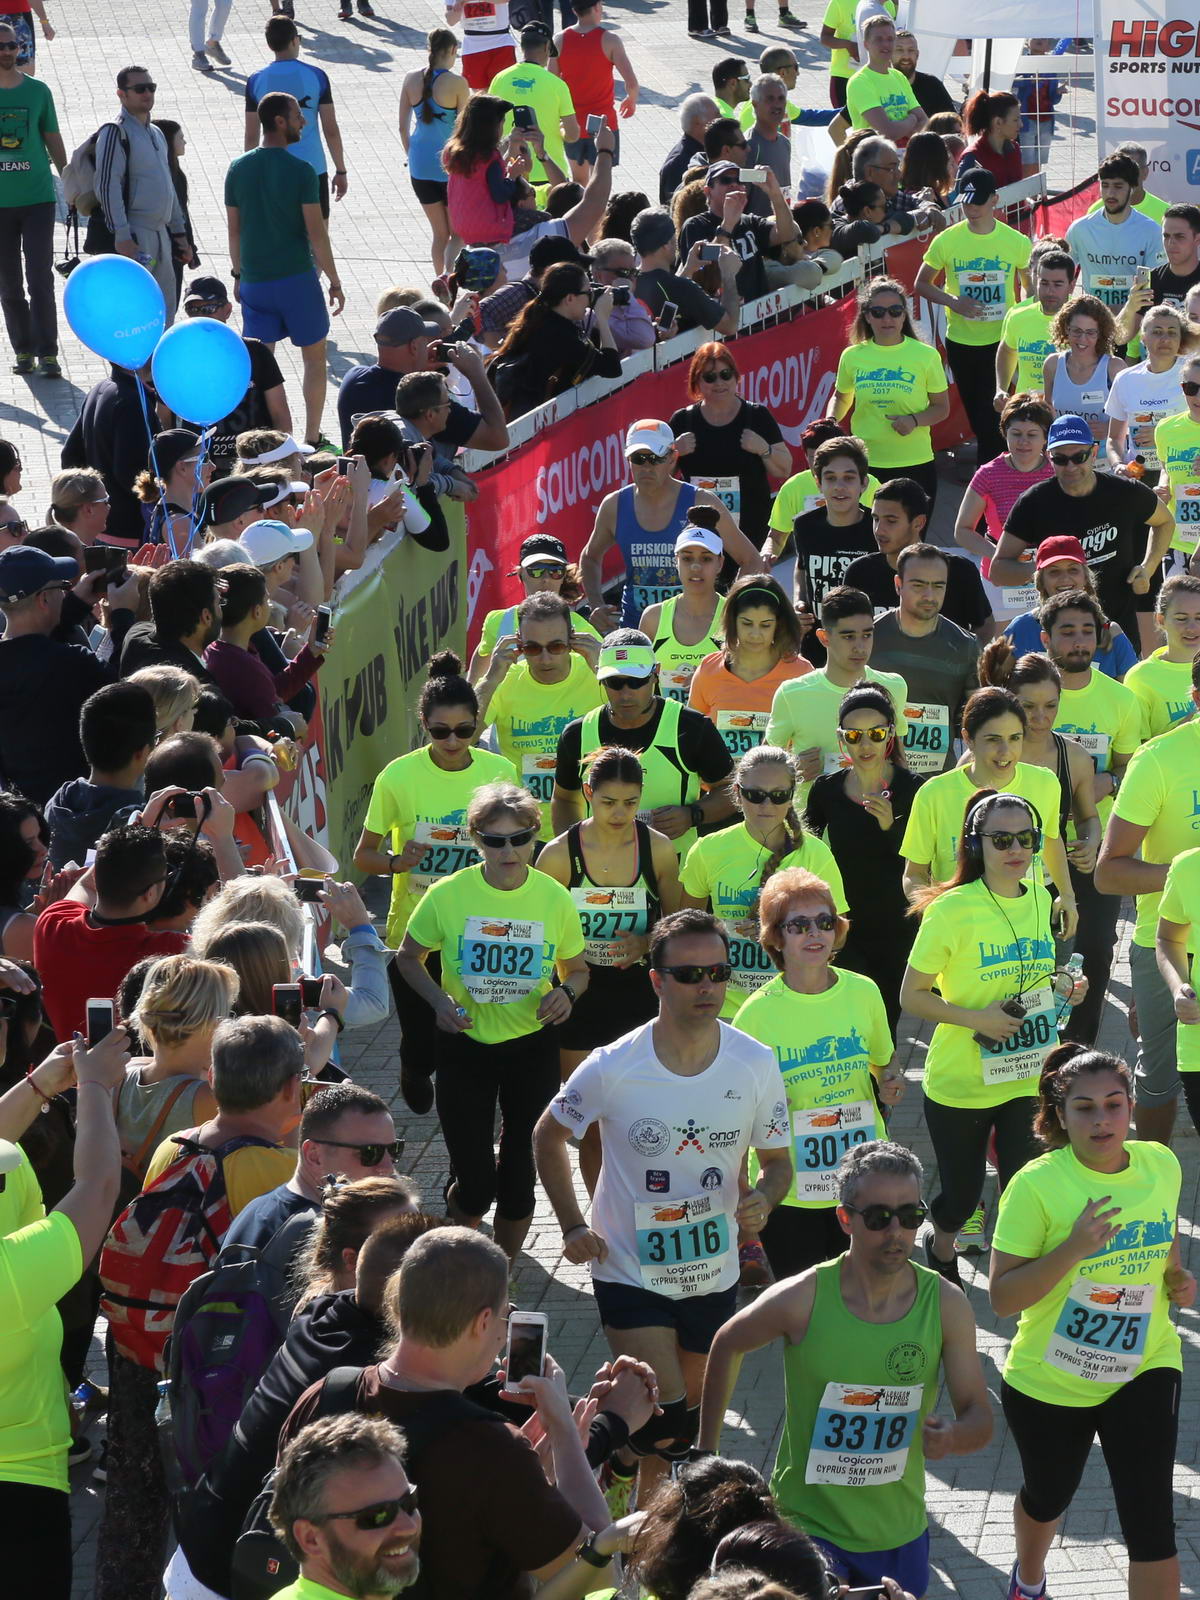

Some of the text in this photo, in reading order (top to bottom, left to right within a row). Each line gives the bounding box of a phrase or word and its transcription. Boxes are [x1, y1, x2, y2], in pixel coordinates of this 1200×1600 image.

[1109, 62, 1167, 73] SPORTS
[1, 161, 31, 171] JEANS
[963, 285, 1002, 304] 3204
[1139, 399, 1169, 409] Logicom
[1086, 522, 1111, 538] cyprus
[630, 543, 677, 560] EPISKOP
[631, 556, 679, 571] RUNNERS
[511, 739, 544, 751] CYPRUS
[903, 726, 943, 751] 048
[419, 846, 484, 874] 3276
[580, 912, 639, 939] 3277
[470, 942, 534, 976] 3032
[729, 940, 773, 970] 300
[739, 972, 774, 983] Logicom
[980, 965, 1020, 983] CYPRUS
[1014, 972, 1040, 984] 2017
[483, 978, 518, 988] Logicom
[467, 987, 530, 996] CYPRUS 5KM FUN RUN
[491, 994, 505, 1003] 2017
[1004, 1051, 1040, 1063] Logicom
[990, 1064, 1014, 1076] CYPRUS
[1015, 1061, 1031, 1072] 5KM
[1016, 1069, 1031, 1080] 2017
[784, 1067, 823, 1088] CYPRUS
[820, 1072, 852, 1087] 2017
[814, 1087, 855, 1104] Logicom
[805, 1181, 831, 1192] CYPRUS
[647, 1220, 722, 1262] 3116
[666, 1261, 709, 1276] Logicom
[1079, 1255, 1125, 1277] CYPRUS
[1119, 1262, 1150, 1276] 2017
[650, 1266, 722, 1287] CYPRUS 5KM FUN RUN
[681, 1283, 698, 1293] 2017
[1066, 1307, 1142, 1351] 3275
[1054, 1349, 1128, 1373] CYPRUS 5KM FUN RUN
[1075, 1346, 1117, 1364] Logicom
[1080, 1369, 1098, 1381] 2017
[824, 1413, 908, 1451] 3318
[838, 1454, 883, 1467] Logicom
[816, 1464, 898, 1476] CYPRUS 5KM FUN RUN
[847, 1476, 866, 1486] 2017
